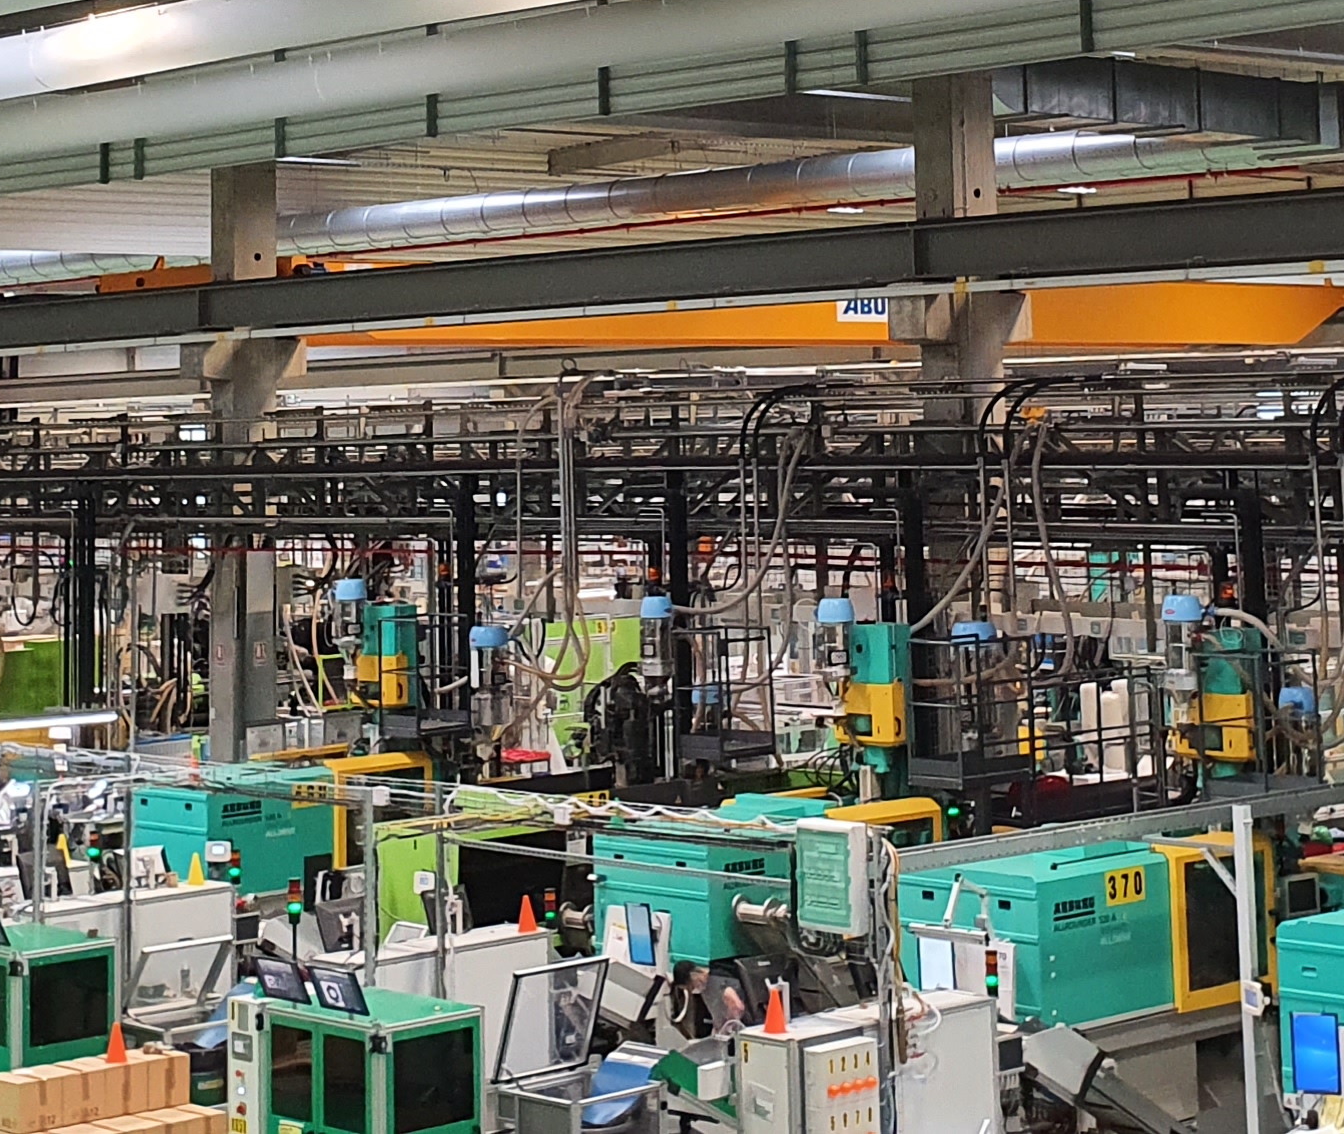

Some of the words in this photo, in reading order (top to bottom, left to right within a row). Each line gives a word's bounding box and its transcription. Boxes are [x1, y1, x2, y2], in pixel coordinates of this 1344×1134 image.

[843, 298, 886, 315] ABU
[1108, 870, 1143, 900] 370
[1053, 896, 1095, 915] ARBURG
